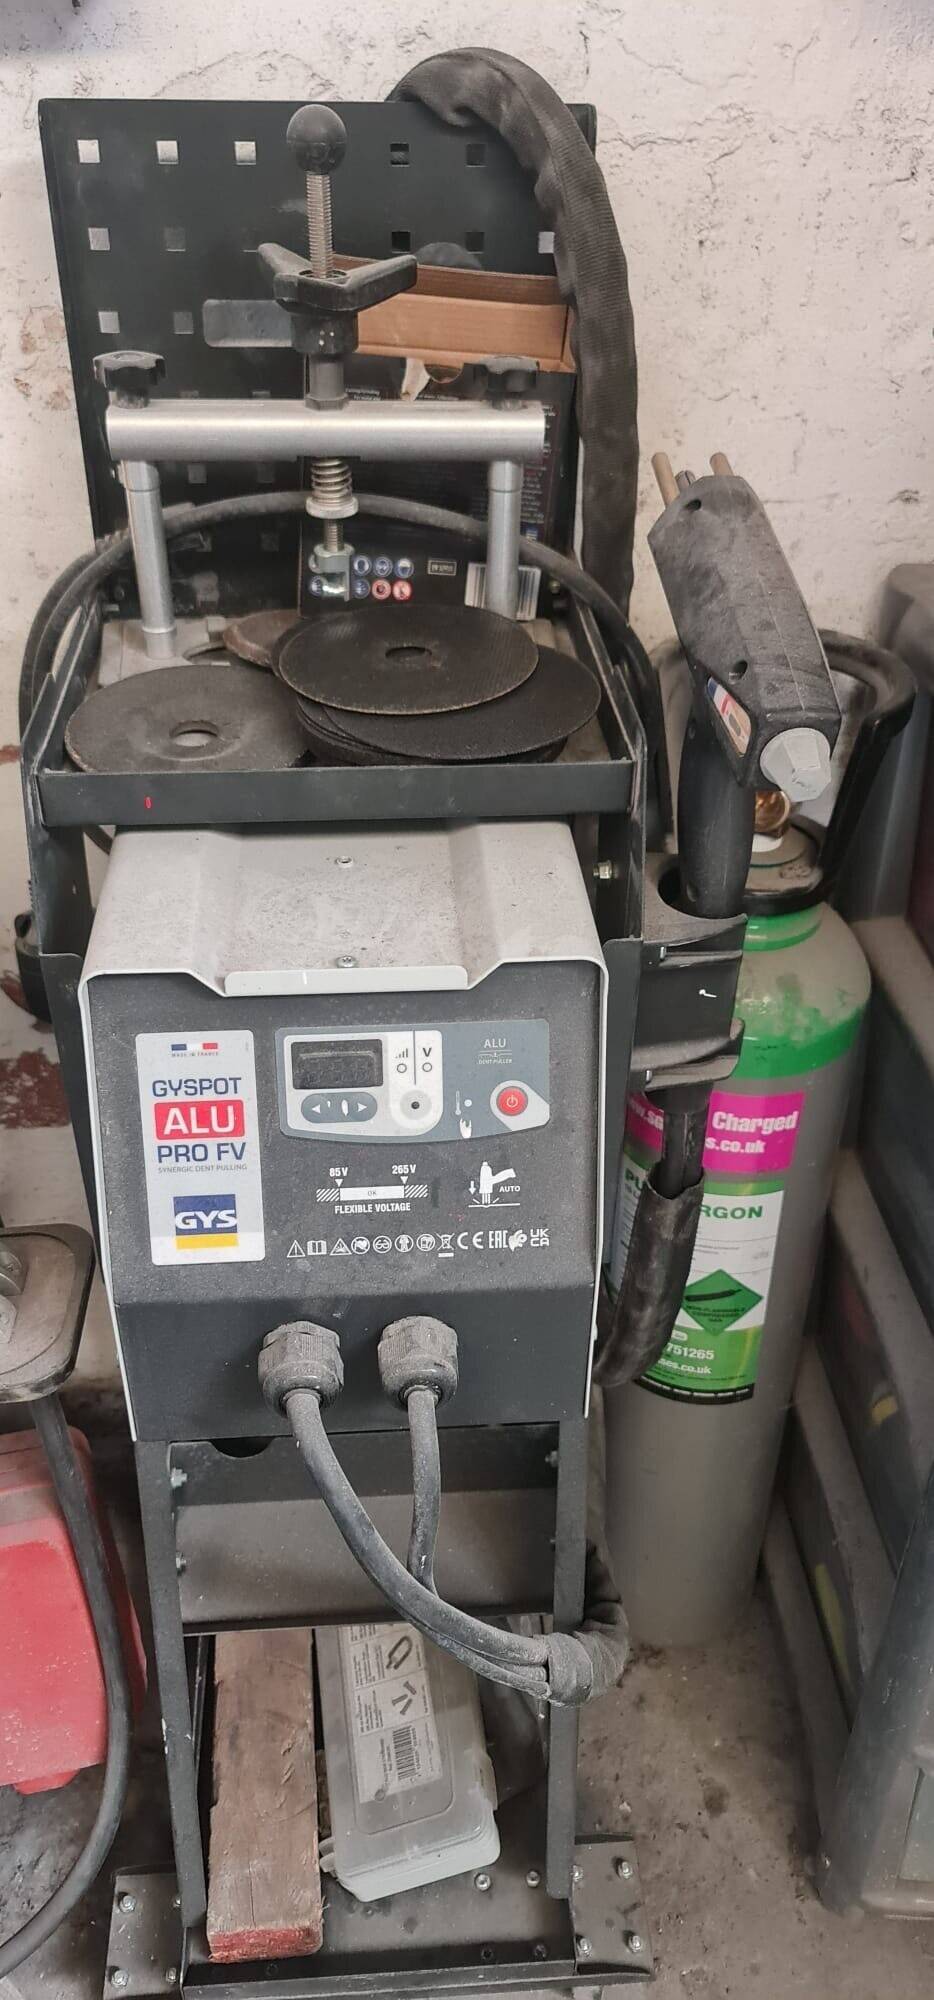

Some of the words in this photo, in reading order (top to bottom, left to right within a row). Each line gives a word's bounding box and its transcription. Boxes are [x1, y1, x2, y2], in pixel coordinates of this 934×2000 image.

[484, 1038, 507, 1049] ALU
[422, 1047, 433, 1058] V
[152, 1077, 242, 1097] GYSPOT
[163, 1105, 236, 1135] ALU
[712, 1111, 799, 1135] Charged
[157, 1143, 209, 1163] PRO
[216, 1142, 247, 1161] FV
[158, 1165, 194, 1174] SYNERGIC
[195, 1164, 214, 1173] DENT
[217, 1162, 248, 1171] PULLING
[499, 1185, 521, 1193] AUTO
[334, 1203, 373, 1214] FLEXIBLE
[375, 1202, 411, 1213] VOLTAGE
[175, 1209, 238, 1231] GYS
